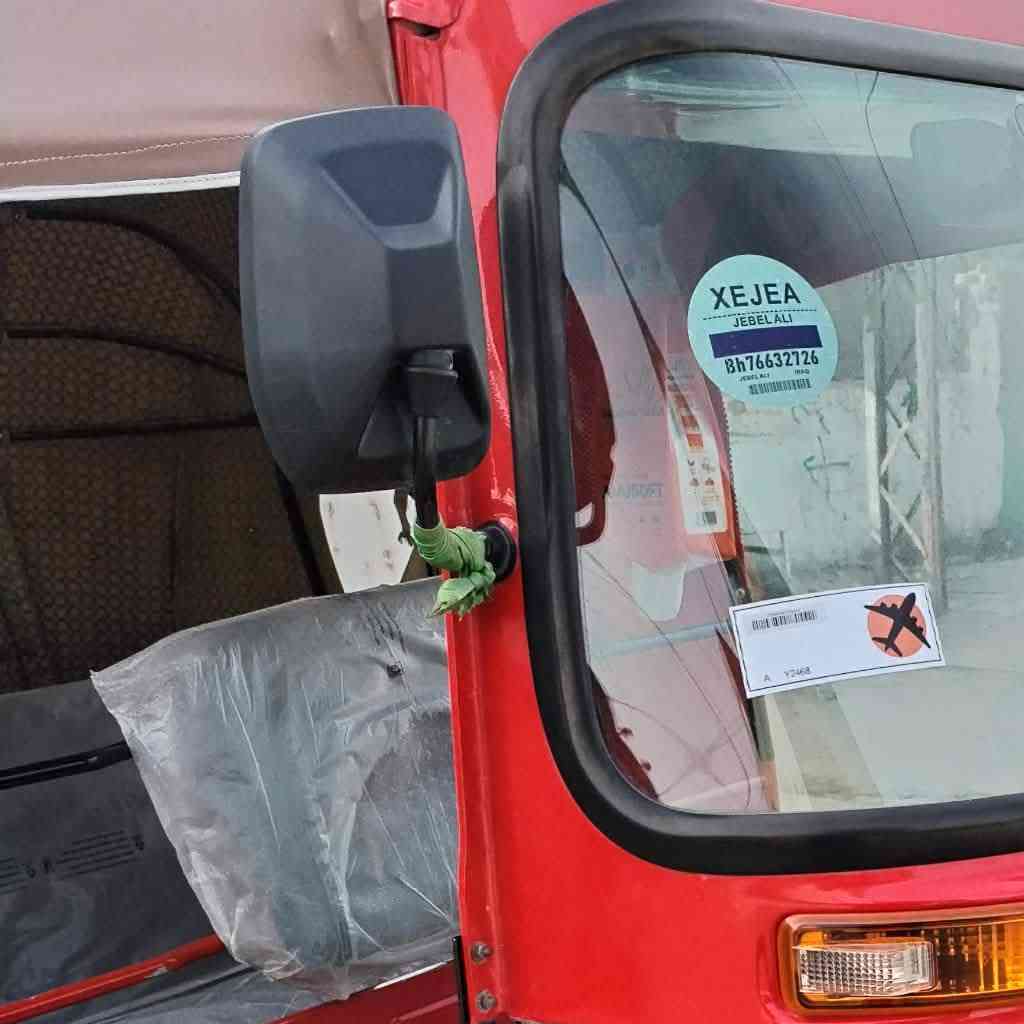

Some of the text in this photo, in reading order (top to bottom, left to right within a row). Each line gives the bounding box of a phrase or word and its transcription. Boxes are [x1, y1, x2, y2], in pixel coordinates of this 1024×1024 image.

[710, 282, 801, 310] XEJEA
[733, 313, 793, 328] JEBEL ALI
[725, 350, 819, 374] Bh76632726
